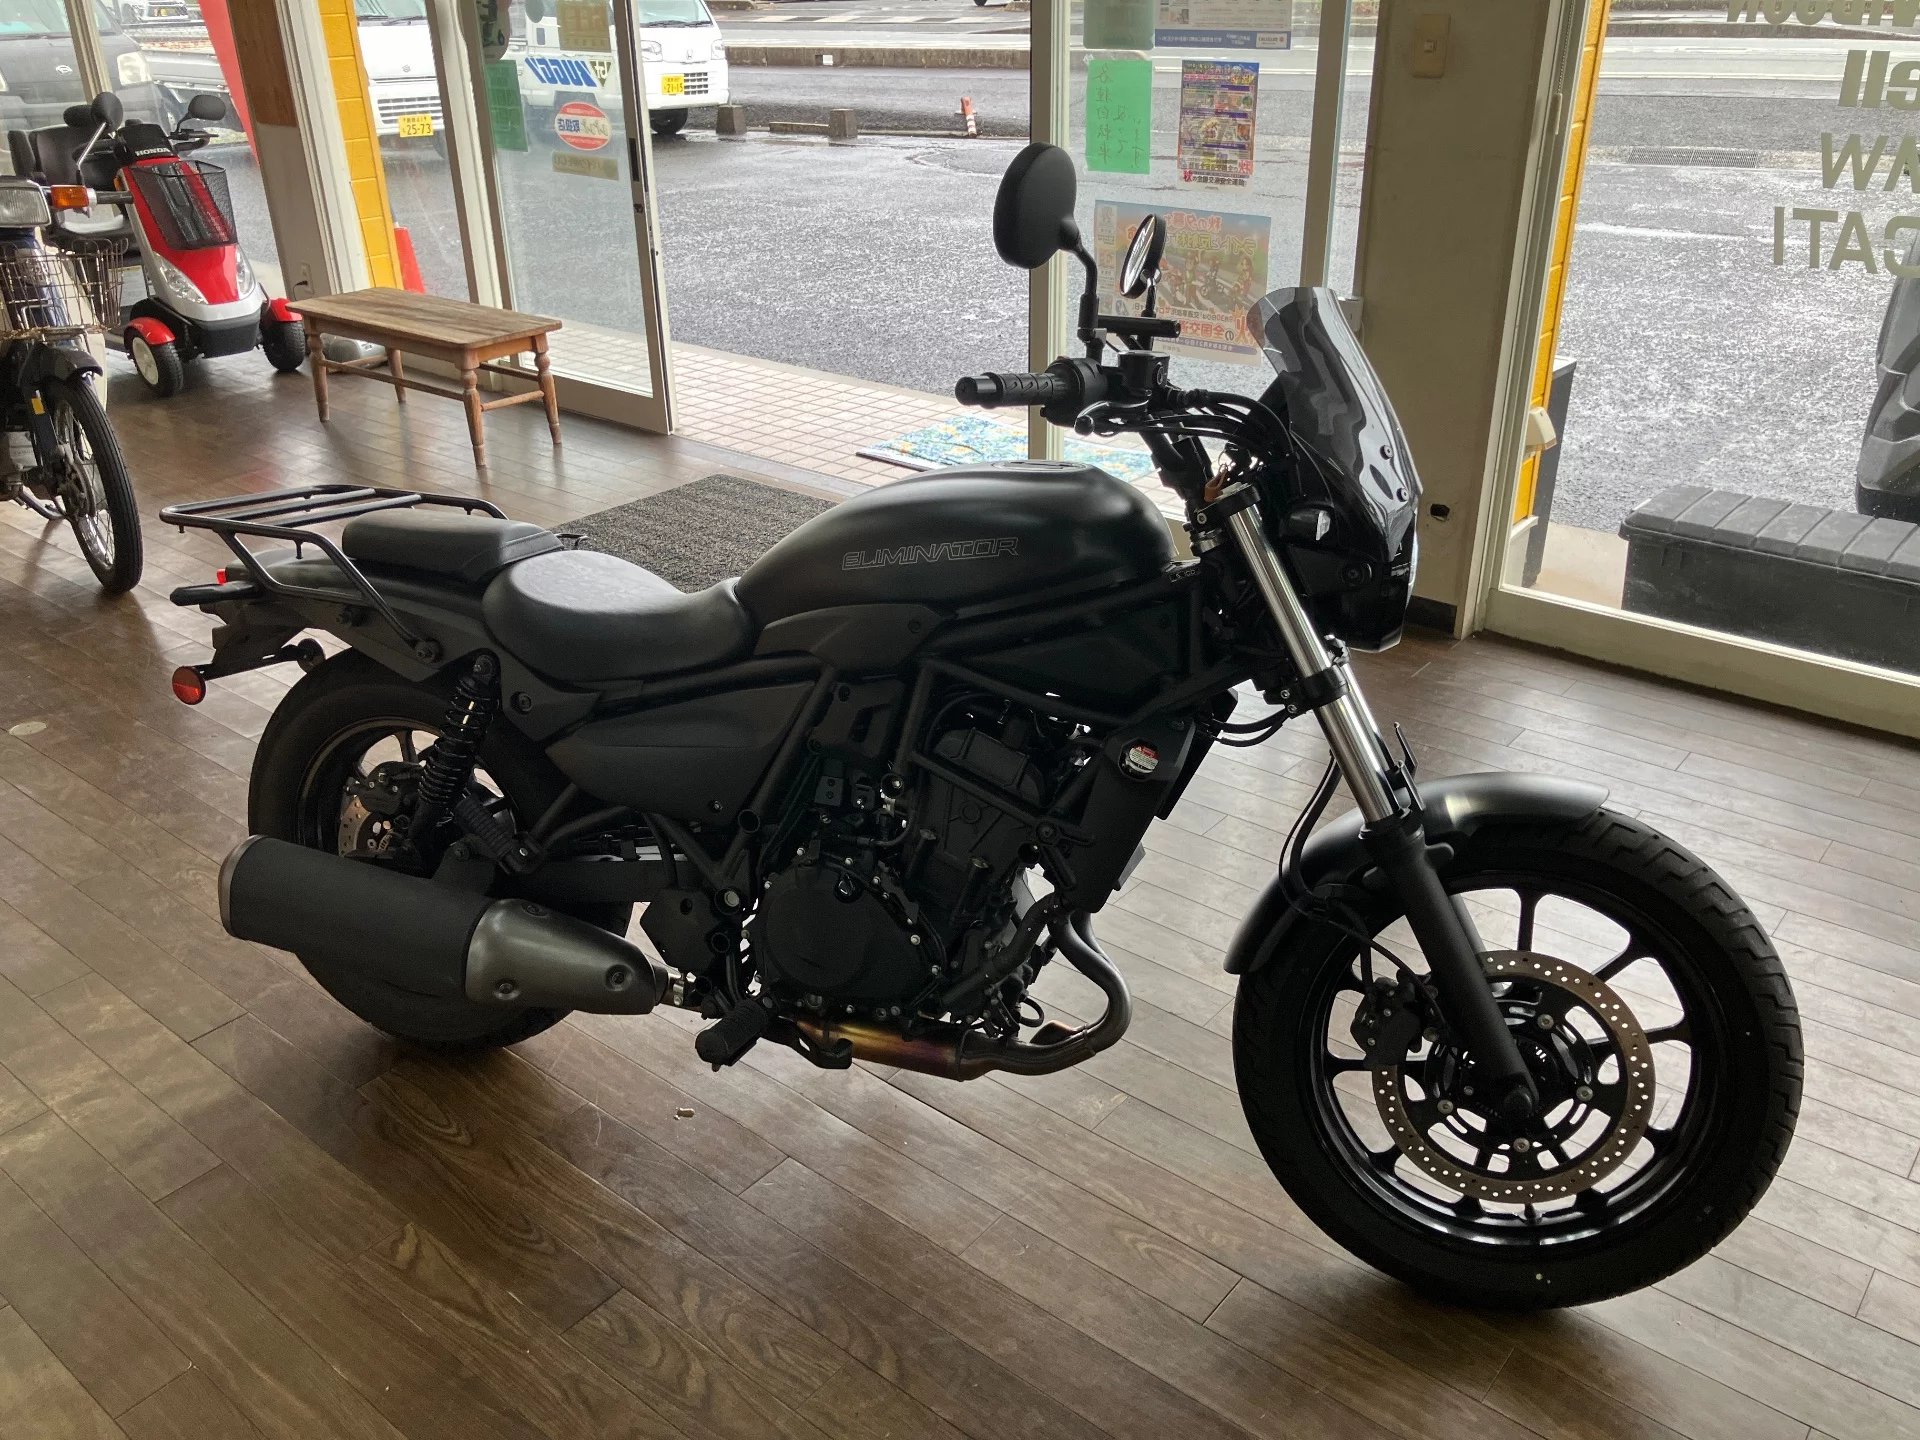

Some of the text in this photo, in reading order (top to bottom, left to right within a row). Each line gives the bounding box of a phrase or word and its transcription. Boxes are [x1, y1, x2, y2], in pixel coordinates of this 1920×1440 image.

[407, 123, 431, 135] 25-73
[135, 147, 170, 156] HONDA
[842, 537, 1019, 571] ELIMINATOR
